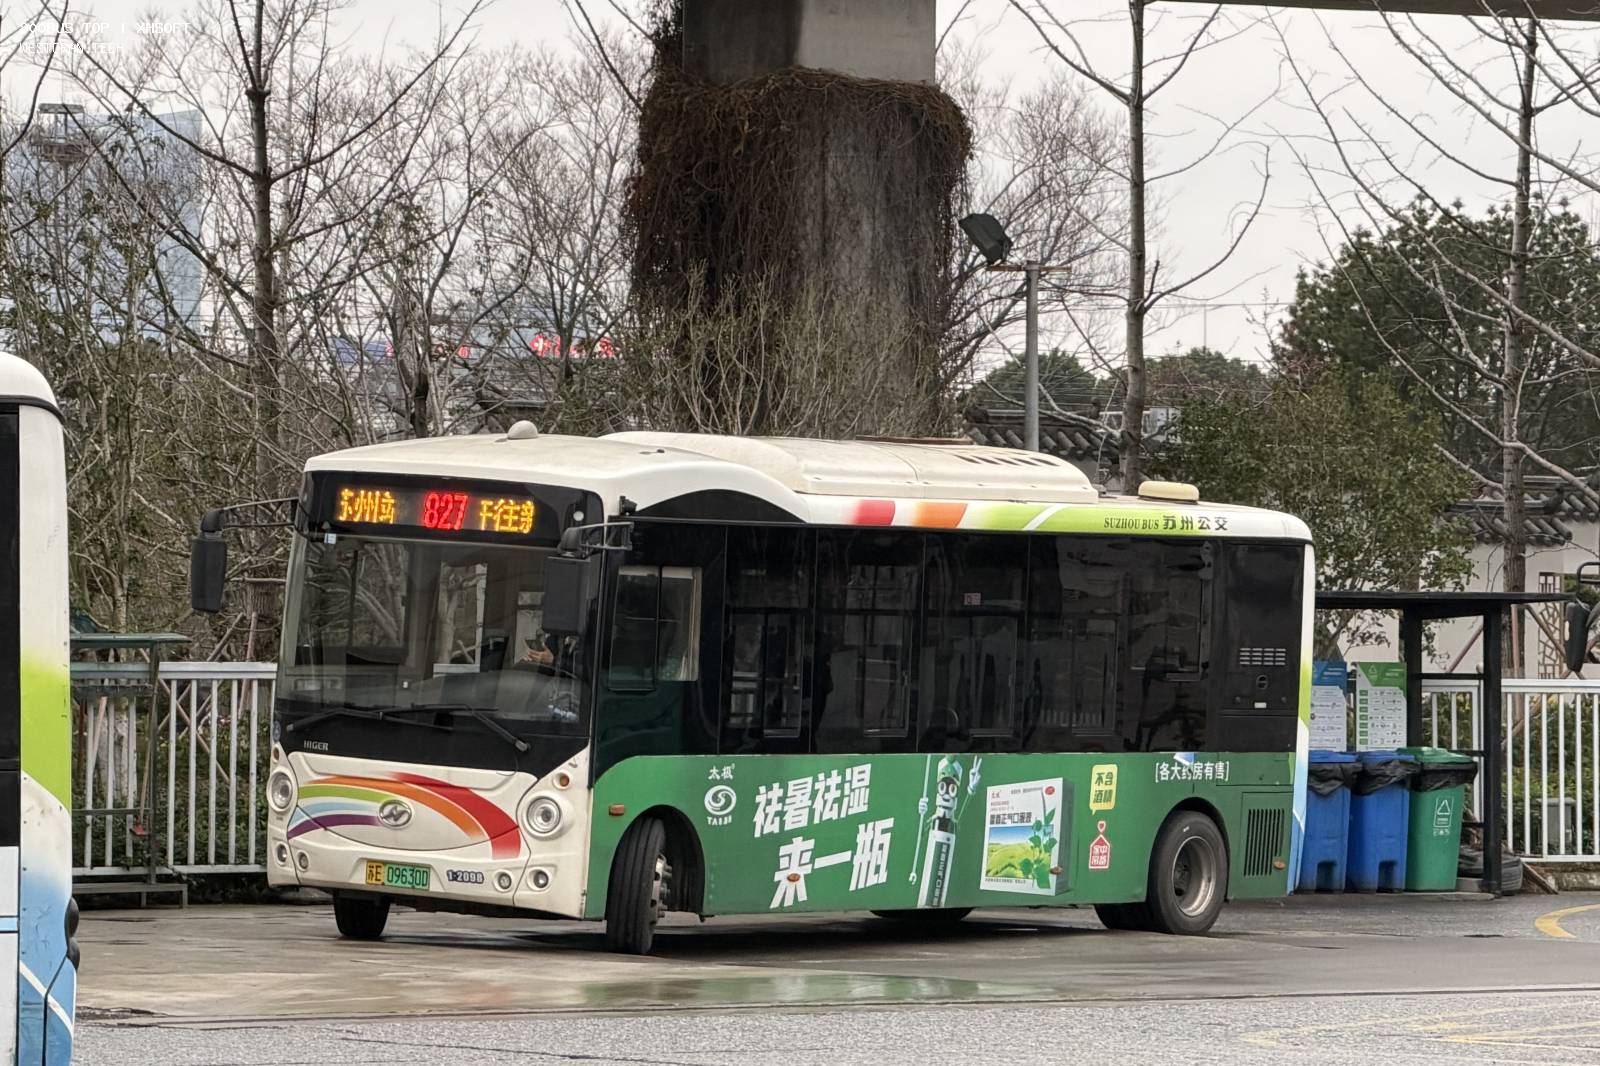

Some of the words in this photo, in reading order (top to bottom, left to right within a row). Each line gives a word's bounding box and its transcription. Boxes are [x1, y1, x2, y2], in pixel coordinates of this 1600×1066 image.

[424, 492, 469, 530] 827
[1104, 517, 1141, 530] SUZHOU
[1142, 518, 1159, 531] BUS
[1163, 515, 1228, 531] 苏州公交
[303, 740, 329, 751] HIGER
[1095, 772, 1113, 787] 不含
[753, 763, 872, 838] 祛暑祛湿
[1092, 789, 1112, 804] 酒精
[769, 817, 895, 909] 来一瓶
